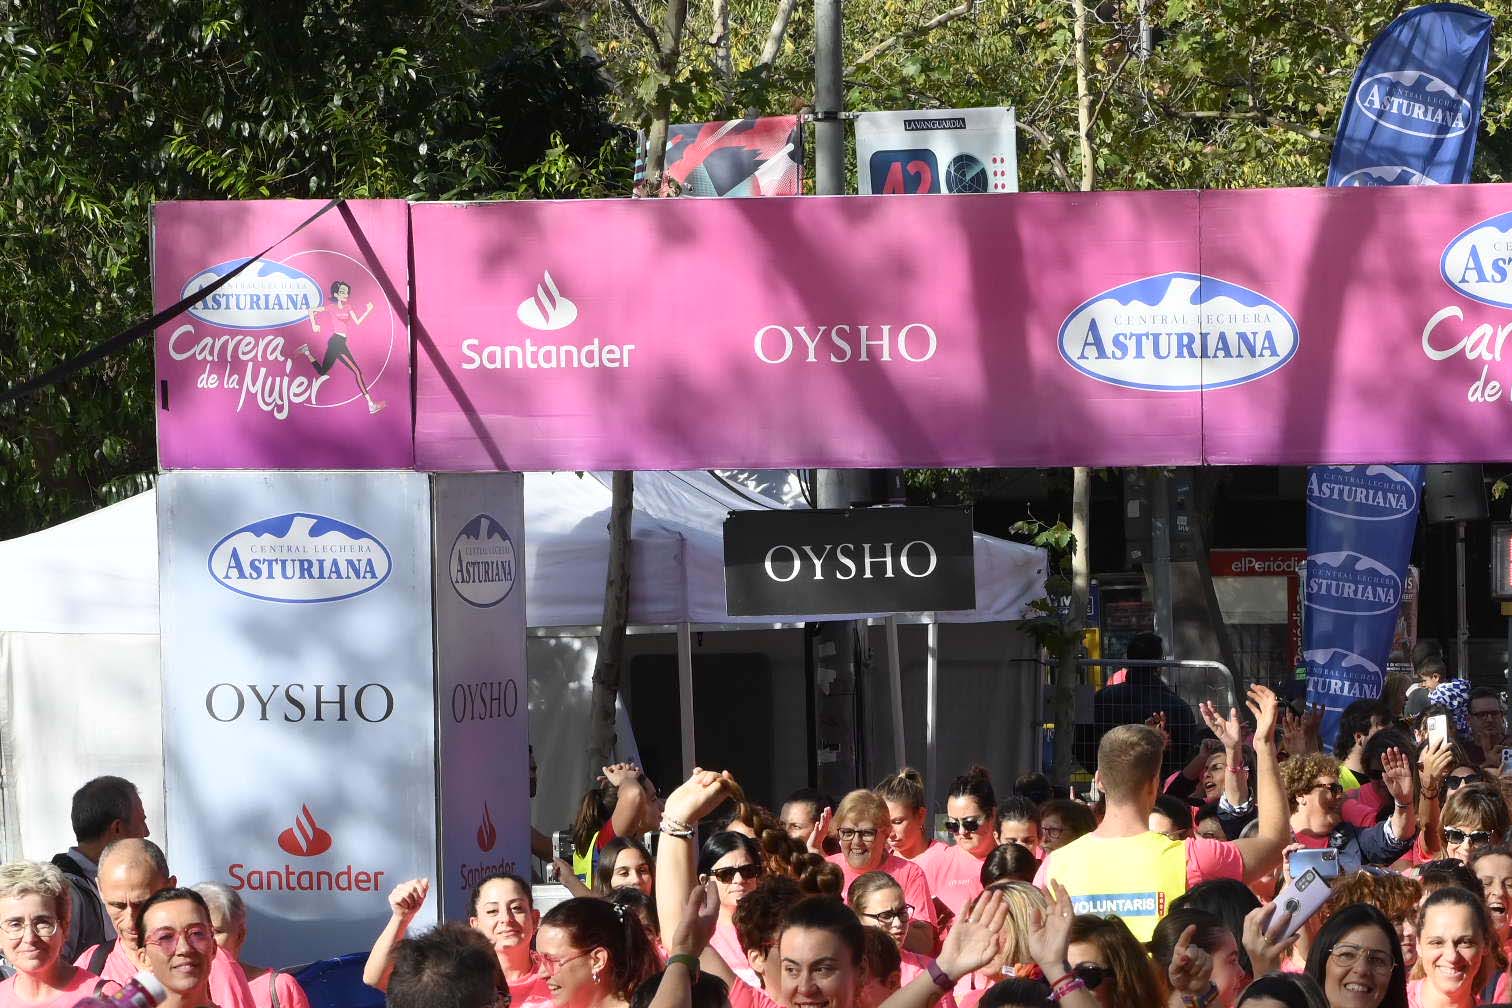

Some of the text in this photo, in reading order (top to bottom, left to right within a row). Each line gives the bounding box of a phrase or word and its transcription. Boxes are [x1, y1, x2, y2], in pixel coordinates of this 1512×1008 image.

[1364, 84, 1465, 128] ASTURIANA
[1114, 313, 1272, 325] CENTRAL LECHERA
[168, 324, 285, 361] Carrera
[462, 338, 634, 370] Santander
[753, 323, 937, 364] OYSHO
[1077, 318, 1281, 360] ASTURIANA
[197, 358, 330, 420] de la Mujer
[1468, 365, 1502, 402] de
[1307, 472, 1408, 510] ASTURIANA
[223, 547, 378, 580] ASTURIANA
[251, 545, 372, 553] CENTRAL LECHERA
[455, 548, 513, 584] ASTURIANA
[764, 541, 937, 582] OYSHO
[1307, 578, 1395, 604] STURIANA
[205, 682, 394, 723] OYSHO
[452, 679, 518, 723] OYSHO
[228, 863, 384, 891] Santander
[1073, 898, 1155, 914] VOLUNTARIS
